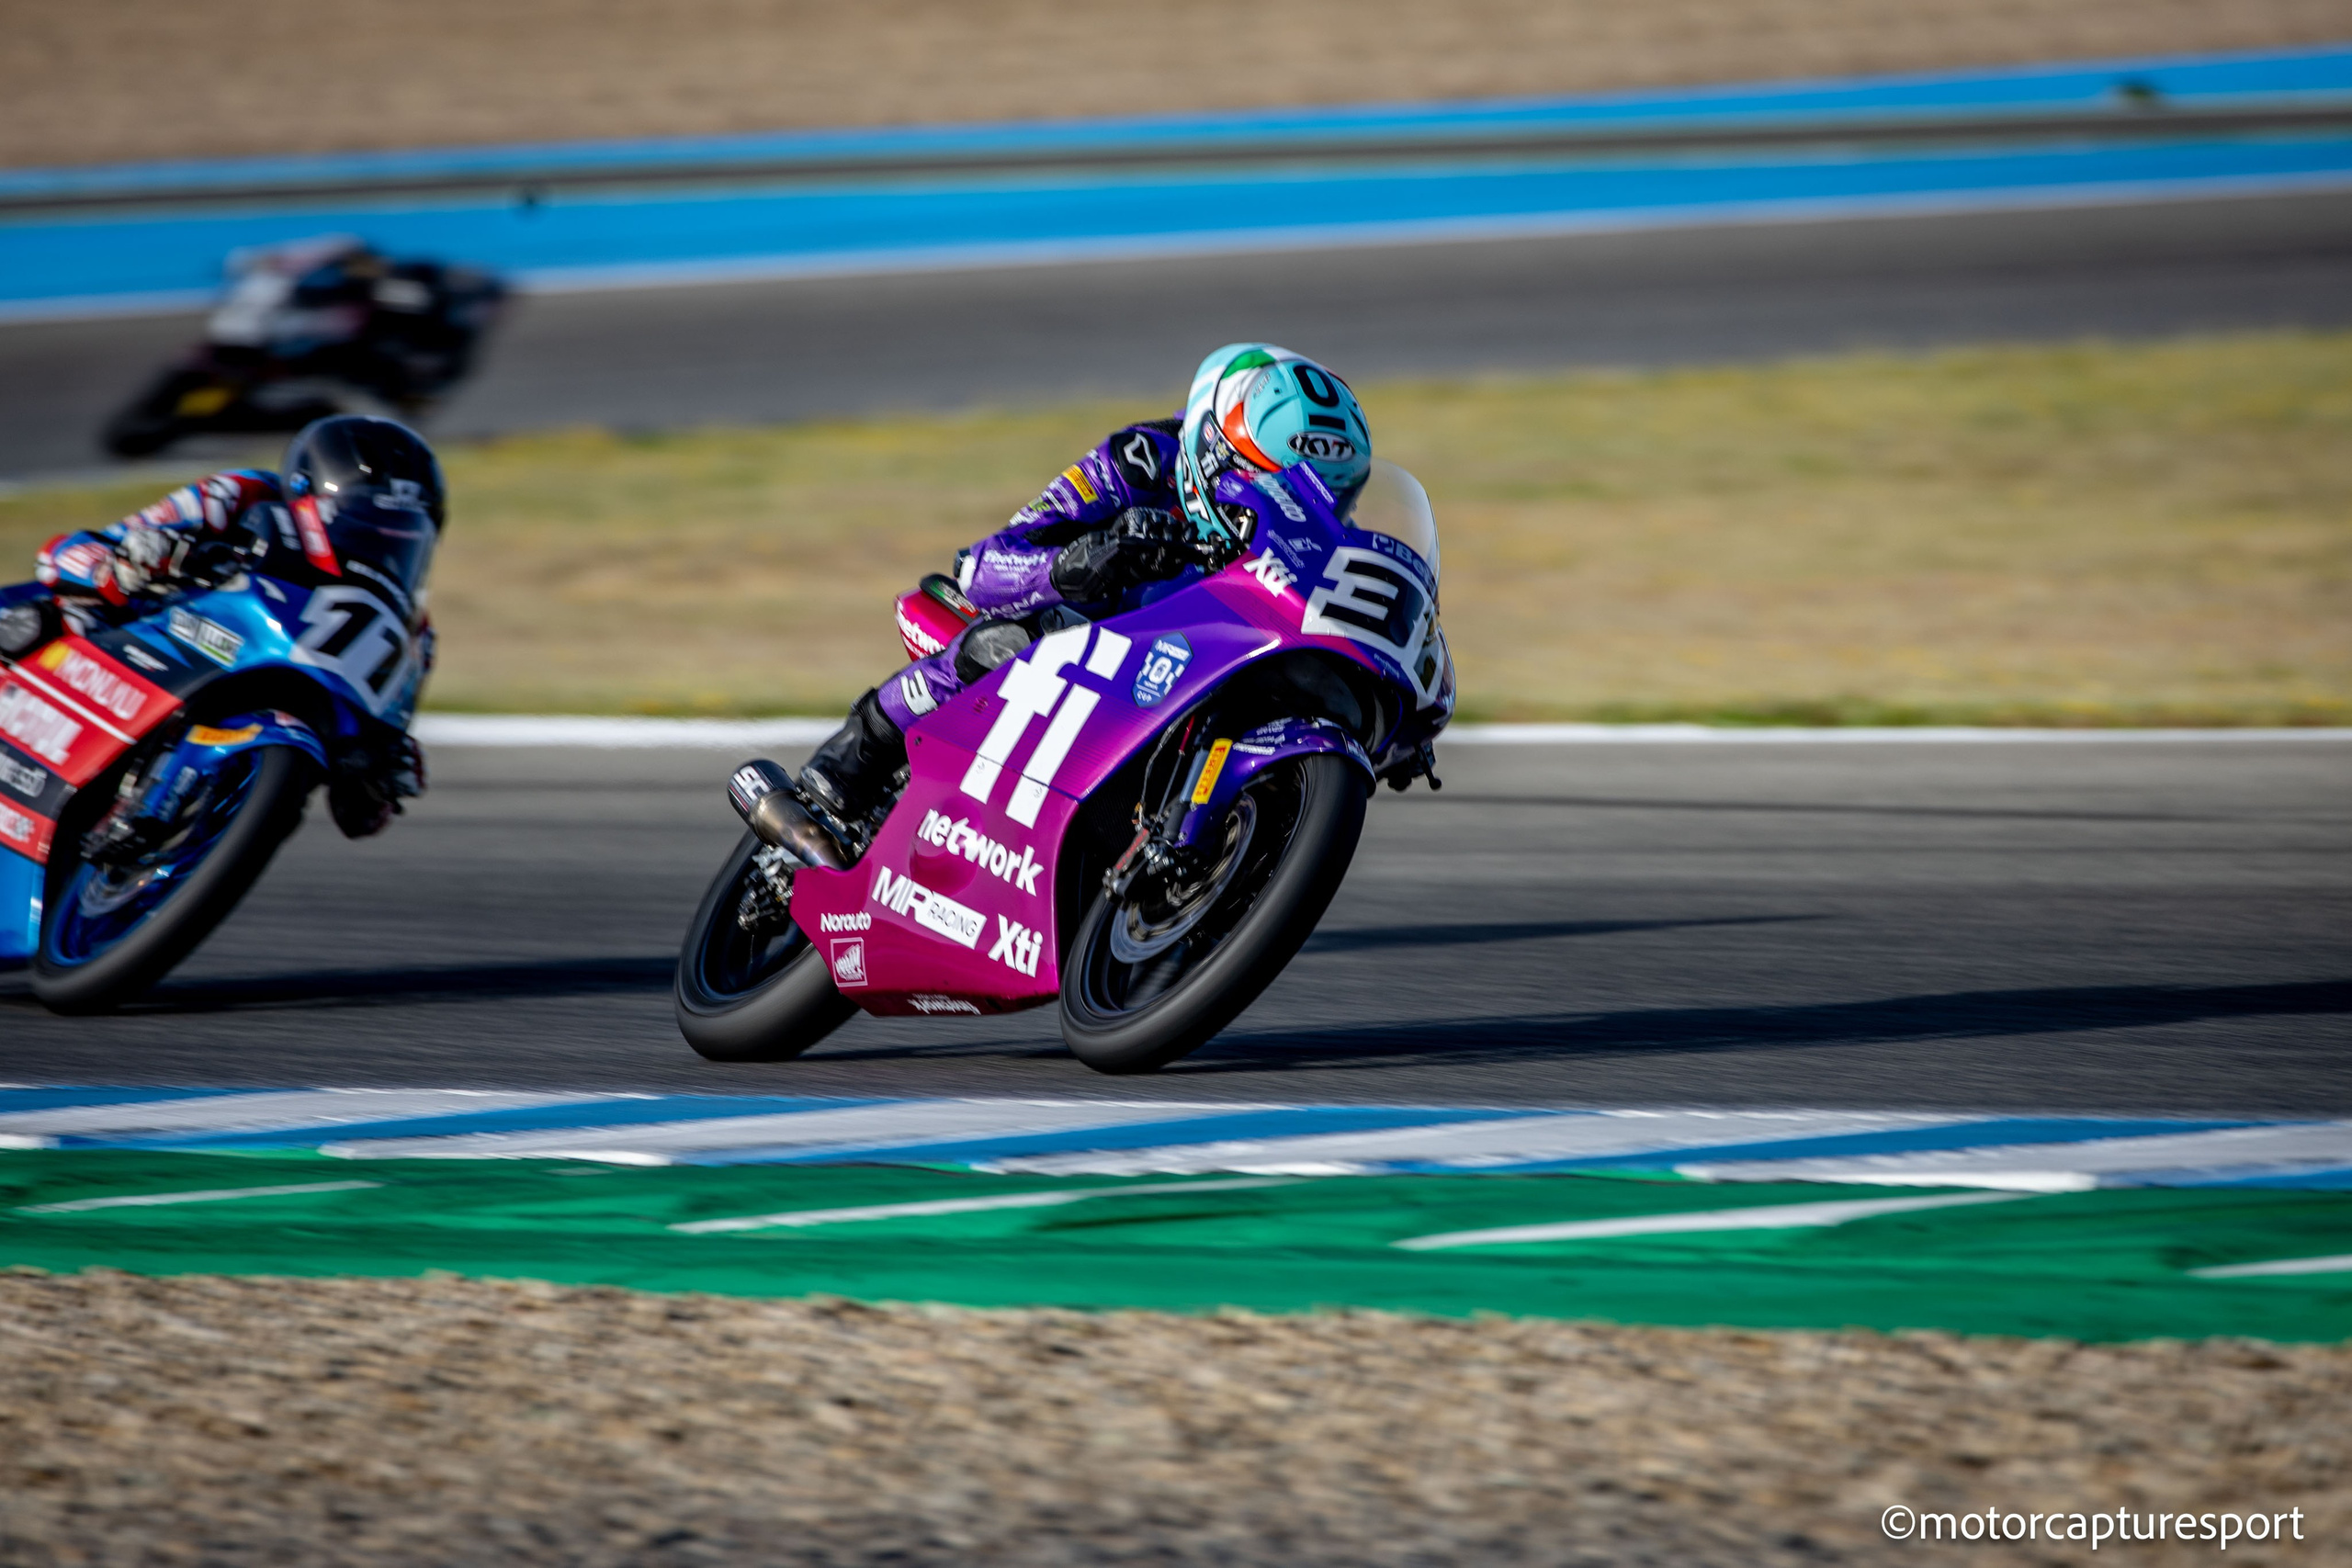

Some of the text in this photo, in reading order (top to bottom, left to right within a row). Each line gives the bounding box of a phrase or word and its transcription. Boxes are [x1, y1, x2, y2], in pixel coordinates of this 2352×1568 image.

[959, 623, 1133, 829] fi
[918, 808, 1044, 897] network
[820, 910, 872, 932] Norauto
[925, 899, 979, 939] RACING
[988, 913, 1045, 978] Xti
